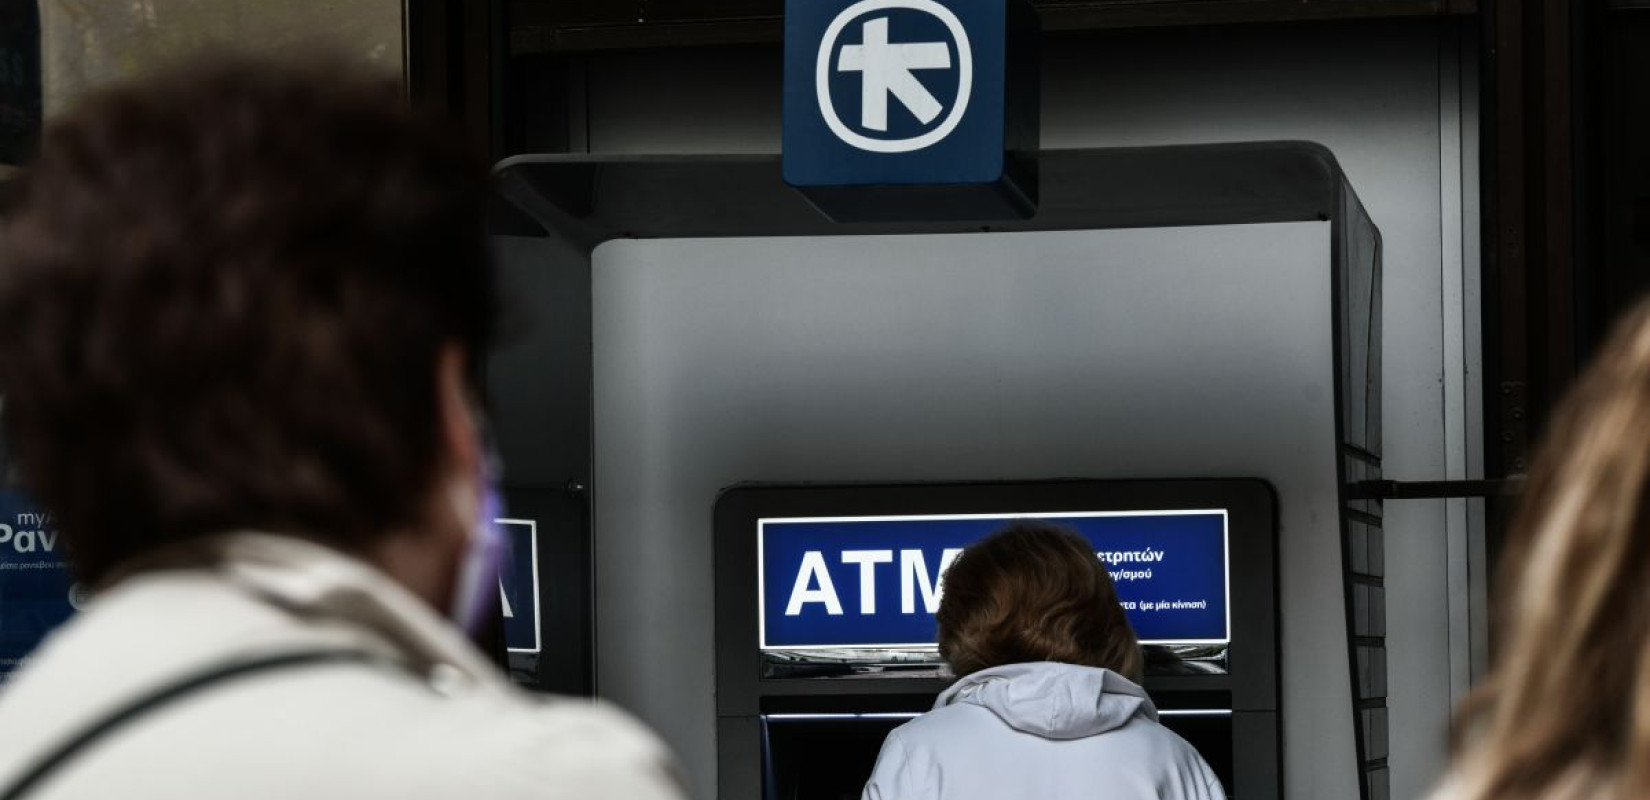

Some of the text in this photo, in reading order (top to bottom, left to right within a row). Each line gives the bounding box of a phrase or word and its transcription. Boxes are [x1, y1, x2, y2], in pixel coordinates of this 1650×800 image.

[1095, 547, 1164, 565] ετρητών
[785, 548, 965, 616] ATM
[1120, 601, 1136, 610] τα
